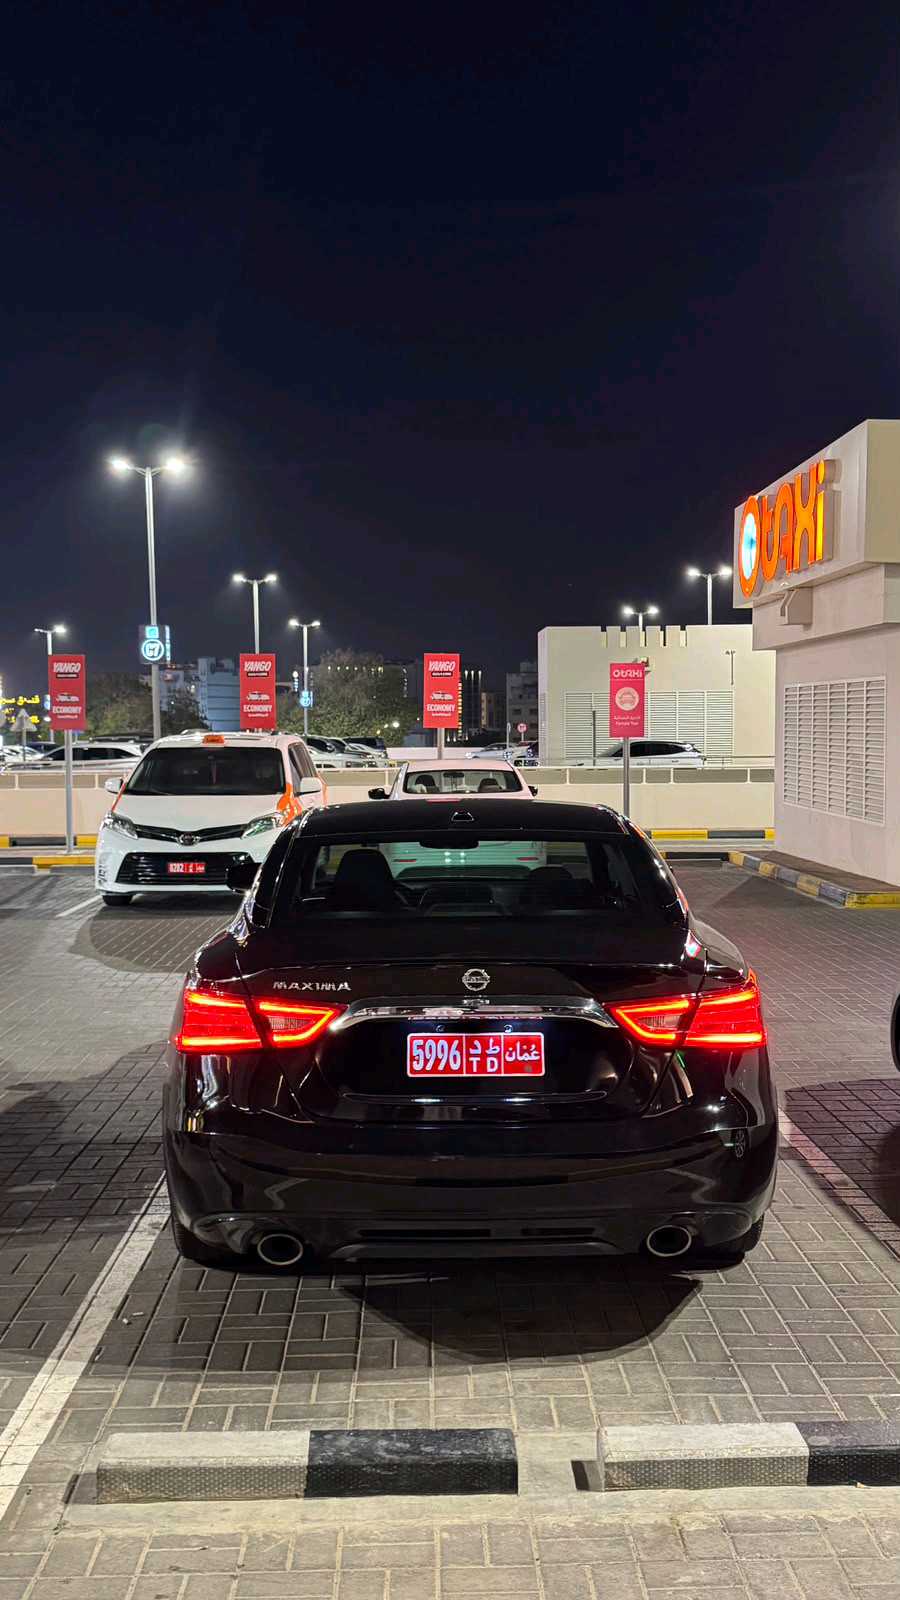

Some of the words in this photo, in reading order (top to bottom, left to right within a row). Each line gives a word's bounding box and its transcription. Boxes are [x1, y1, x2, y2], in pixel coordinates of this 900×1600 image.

[53, 662, 82, 673] YANGO
[244, 661, 272, 672] YANGO
[428, 660, 456, 672] YANGO
[52, 705, 82, 714] ECONOMY
[243, 704, 272, 713] ECONOMY
[426, 703, 455, 712] ECONOMY
[272, 981, 352, 991] MAXIMA
[412, 1039, 462, 1071] 5996
